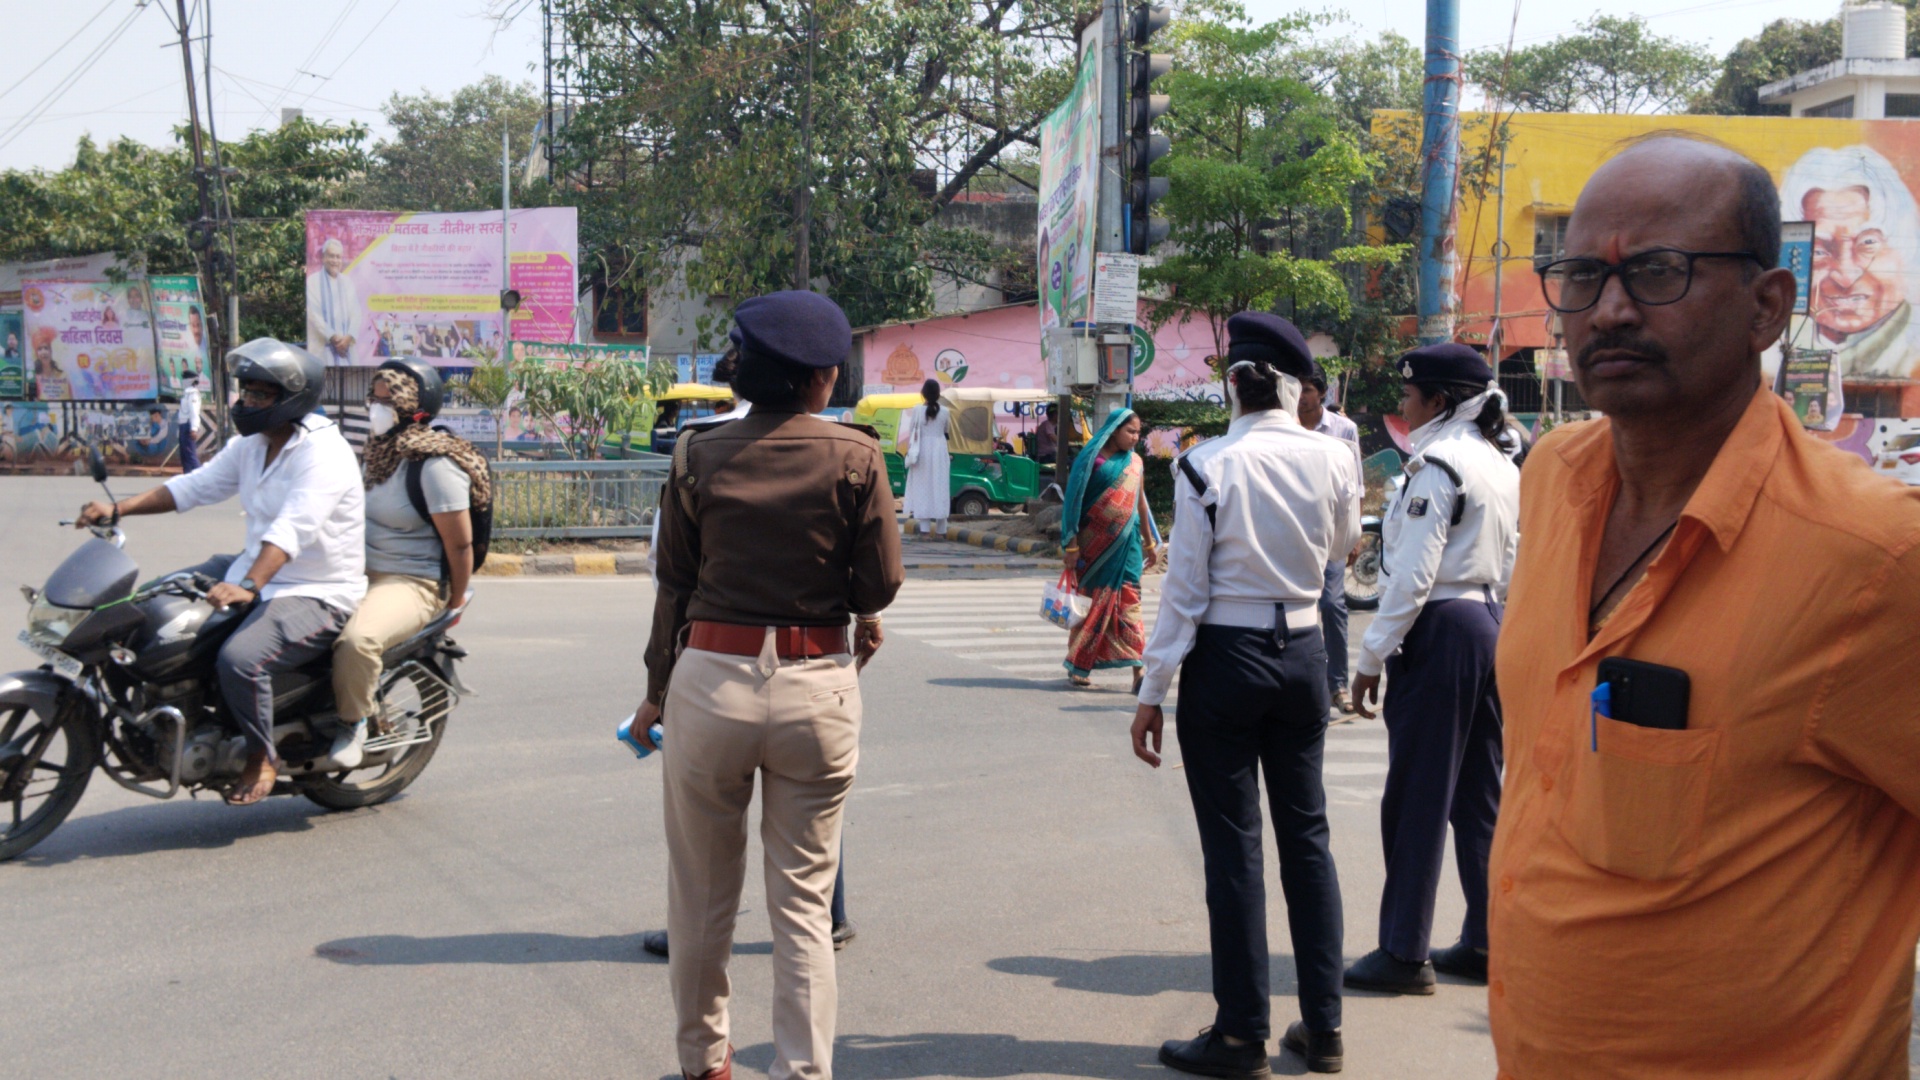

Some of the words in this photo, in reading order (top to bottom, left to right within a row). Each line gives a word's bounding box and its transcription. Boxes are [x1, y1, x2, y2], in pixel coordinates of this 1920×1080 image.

[394, 222, 430, 235] मतलब
[440, 218, 476, 235] नीतीश
[479, 222, 518, 235] सरकर
[60, 326, 93, 344] महिला
[94, 326, 124, 344] दिवस
